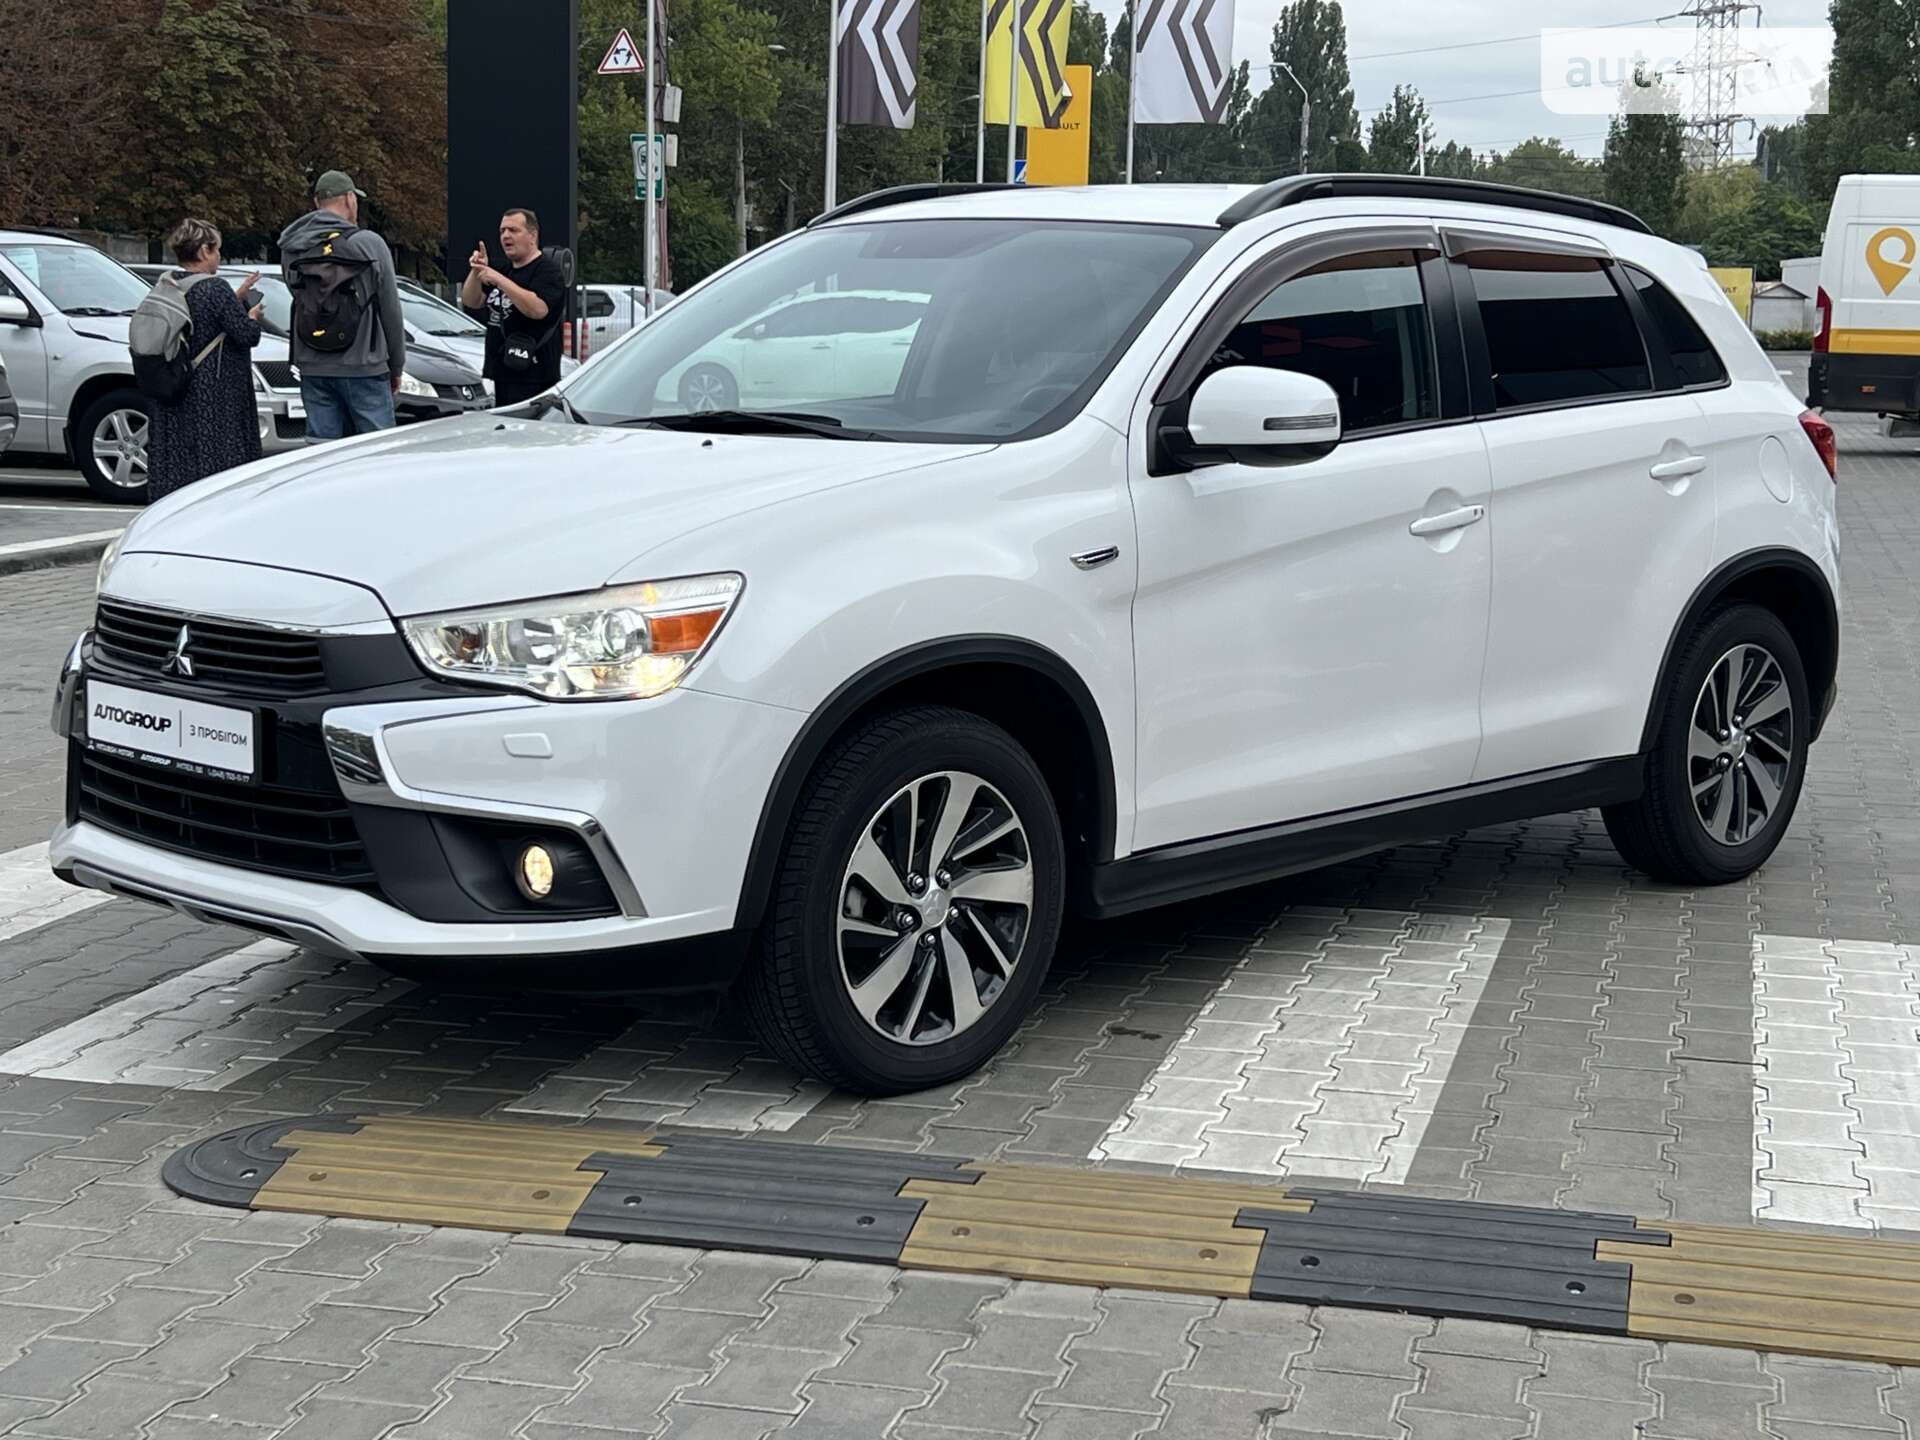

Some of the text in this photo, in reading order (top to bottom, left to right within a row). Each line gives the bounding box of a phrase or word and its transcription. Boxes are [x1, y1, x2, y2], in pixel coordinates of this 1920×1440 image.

[508, 348, 529, 359] FILA
[94, 703, 171, 732] AUTOGROUP
[198, 726, 248, 746] ПРОБІГОМ
